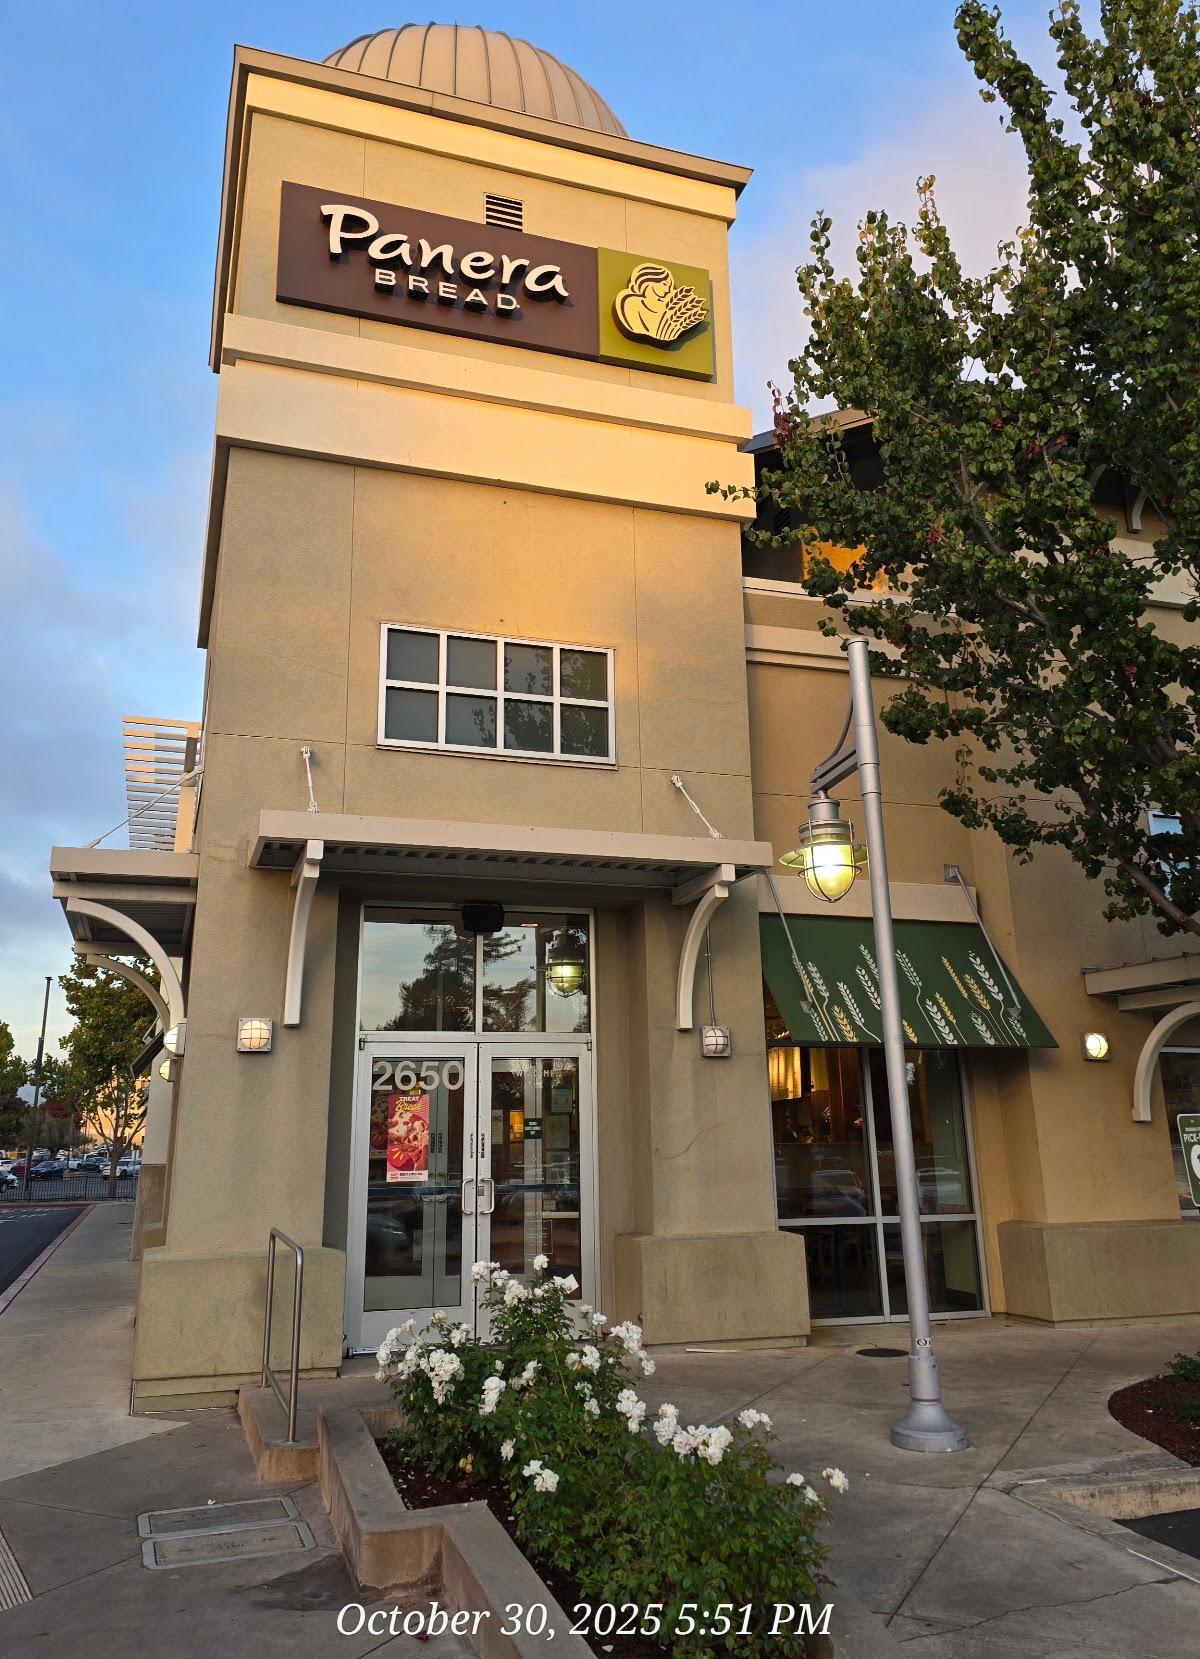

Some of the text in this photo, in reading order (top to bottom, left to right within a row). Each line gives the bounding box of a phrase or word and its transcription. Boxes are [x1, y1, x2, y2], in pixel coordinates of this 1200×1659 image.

[320, 204, 570, 297] Panera
[374, 268, 518, 310] BREAD
[372, 1061, 464, 1090] 2650
[1183, 1133, 1200, 1142] PICK-
